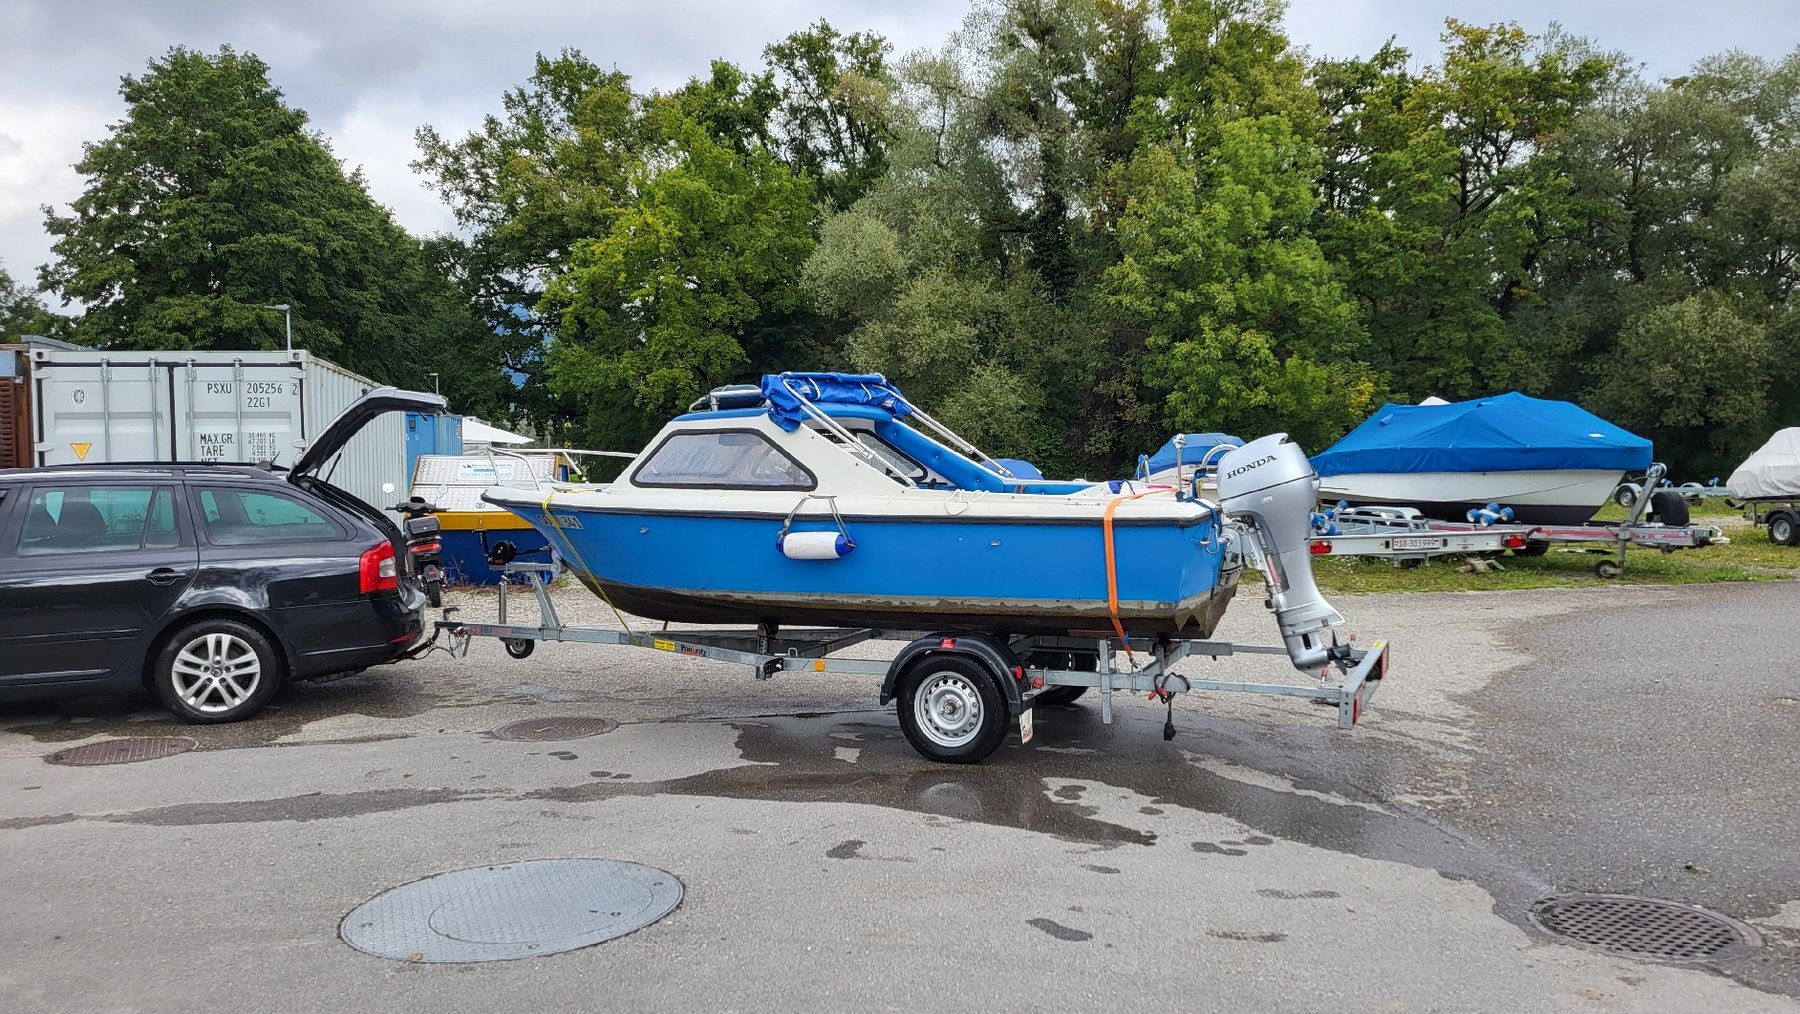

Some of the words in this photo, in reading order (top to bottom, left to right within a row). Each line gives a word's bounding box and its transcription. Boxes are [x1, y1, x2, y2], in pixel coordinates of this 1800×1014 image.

[207, 383, 232, 394] PSXU
[246, 383, 283, 394] 205256
[292, 383, 298, 396] 2
[247, 397, 271, 408] 22G1
[200, 445, 225, 457] TARE
[1226, 455, 1278, 480] HONDA
